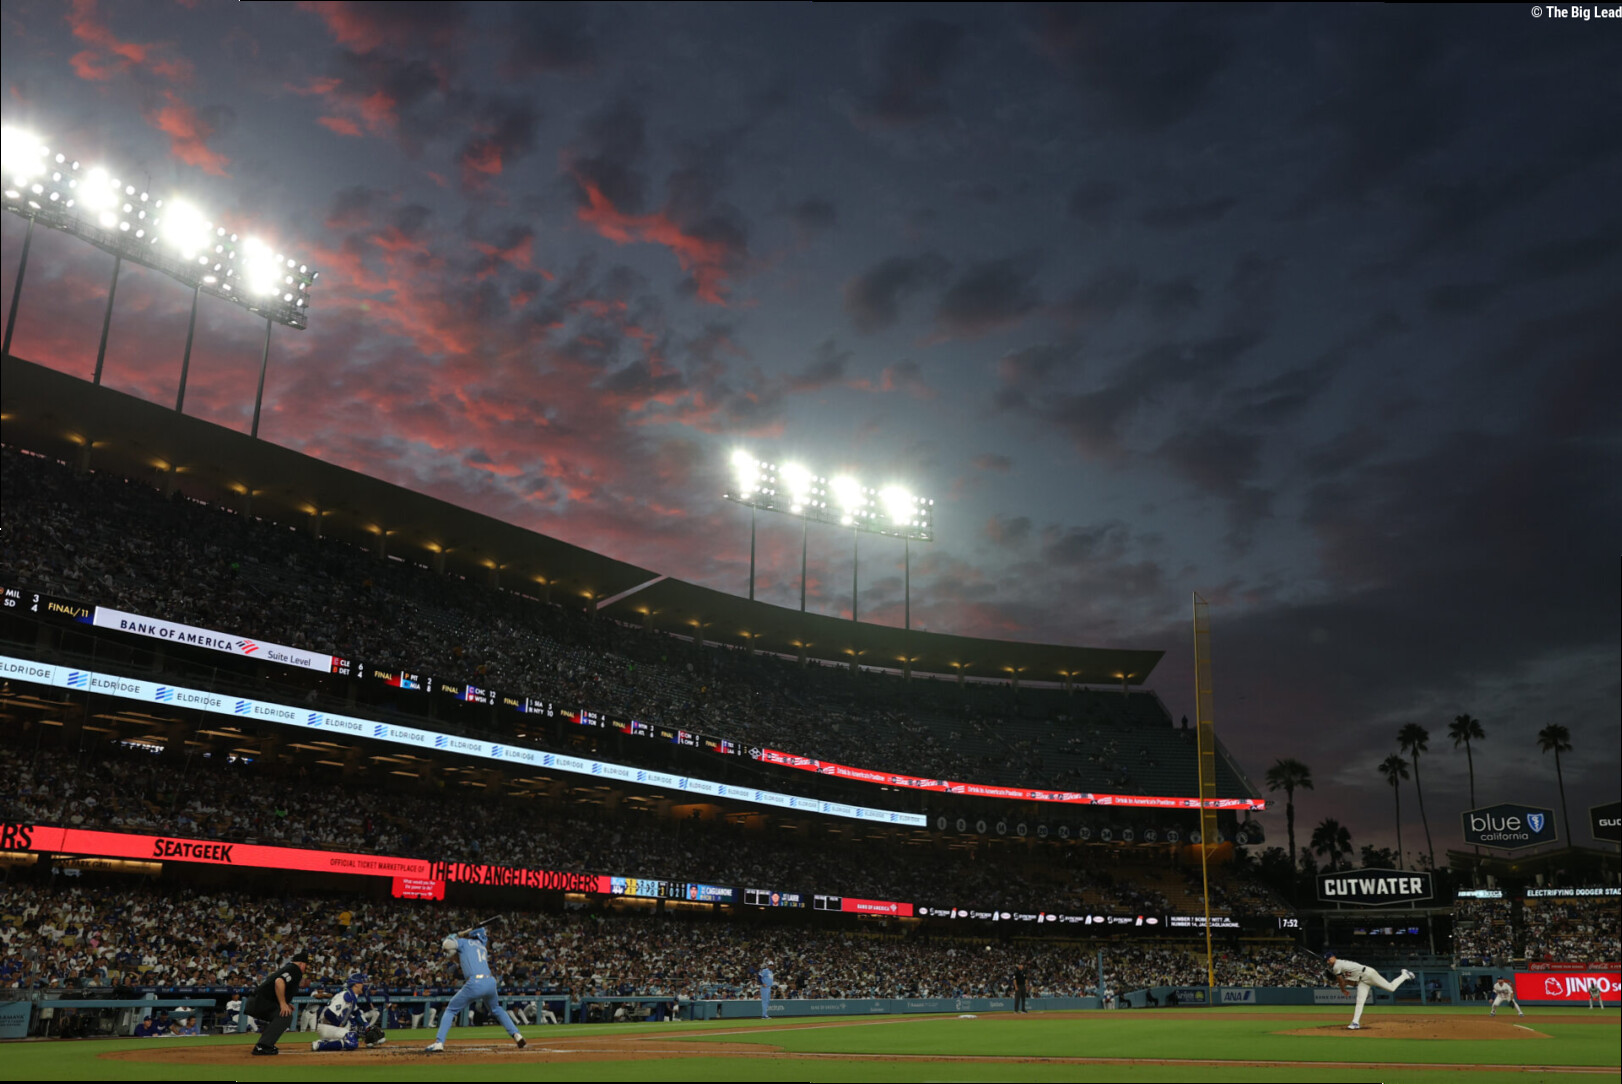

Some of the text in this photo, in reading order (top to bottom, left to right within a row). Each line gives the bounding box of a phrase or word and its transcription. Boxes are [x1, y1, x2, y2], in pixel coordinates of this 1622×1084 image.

[5, 589, 40, 603] MIL 3
[4, 598, 38, 613] SD 4
[120, 619, 233, 650] BANK OF AMERICA
[267, 650, 311, 666] Suite Level
[340, 660, 350, 668] CLE
[339, 667, 350, 675] DET
[374, 671, 392, 680] FINAL
[91, 678, 141, 694] ELDRIDGE
[442, 685, 459, 694] FINAL
[177, 693, 222, 707] ELDRIDGE
[504, 698, 519, 706] FINAL
[254, 706, 296, 719] ELDRIDGE
[561, 710, 574, 718] FINAL
[326, 718, 363, 731] ELDRIDGE
[390, 729, 425, 741] ELDRIDGE
[450, 740, 482, 751] ELDRIDGE
[505, 750, 534, 761] ELDRIDGE
[1471, 814, 1521, 832] blue
[1480, 832, 1528, 841] california
[153, 839, 233, 863] SEATGEEK
[330, 858, 355, 868] OFFICIAL
[358, 861, 377, 869] TICKET
[378, 863, 417, 872] MARKETPLACE
[428, 860, 599, 893] THE LOS ANGELES DODGERS
[1324, 877, 1423, 896] CUTWATER
[1527, 889, 1574, 897] ELECTRIFYING
[1283, 919, 1298, 927] 7:52
[1224, 992, 1242, 1001] ANA
